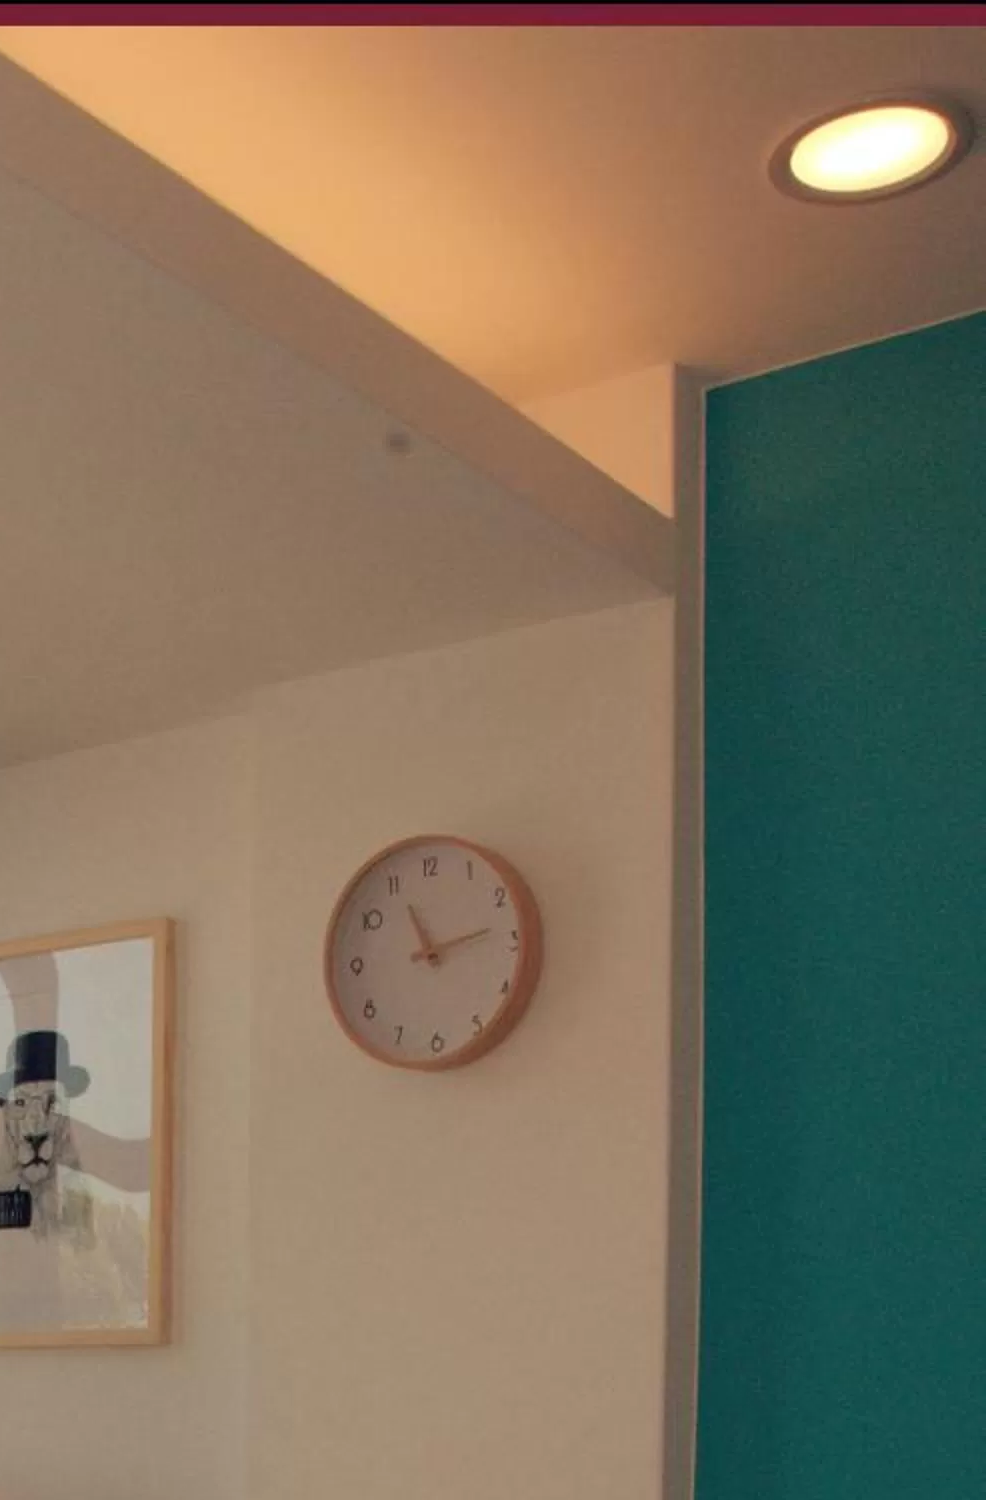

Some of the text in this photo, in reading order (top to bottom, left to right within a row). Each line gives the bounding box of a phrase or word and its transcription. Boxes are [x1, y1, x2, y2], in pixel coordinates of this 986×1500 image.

[422, 855, 439, 878] 12
[465, 859, 474, 881] 1
[387, 875, 400, 897] 11
[494, 886, 506, 908] 2
[362, 909, 383, 932] 10
[349, 956, 364, 976] 9
[363, 998, 377, 1020] 8
[393, 1024, 405, 1046] 7
[471, 1014, 484, 1036] 5
[430, 1031, 445, 1054] 6
